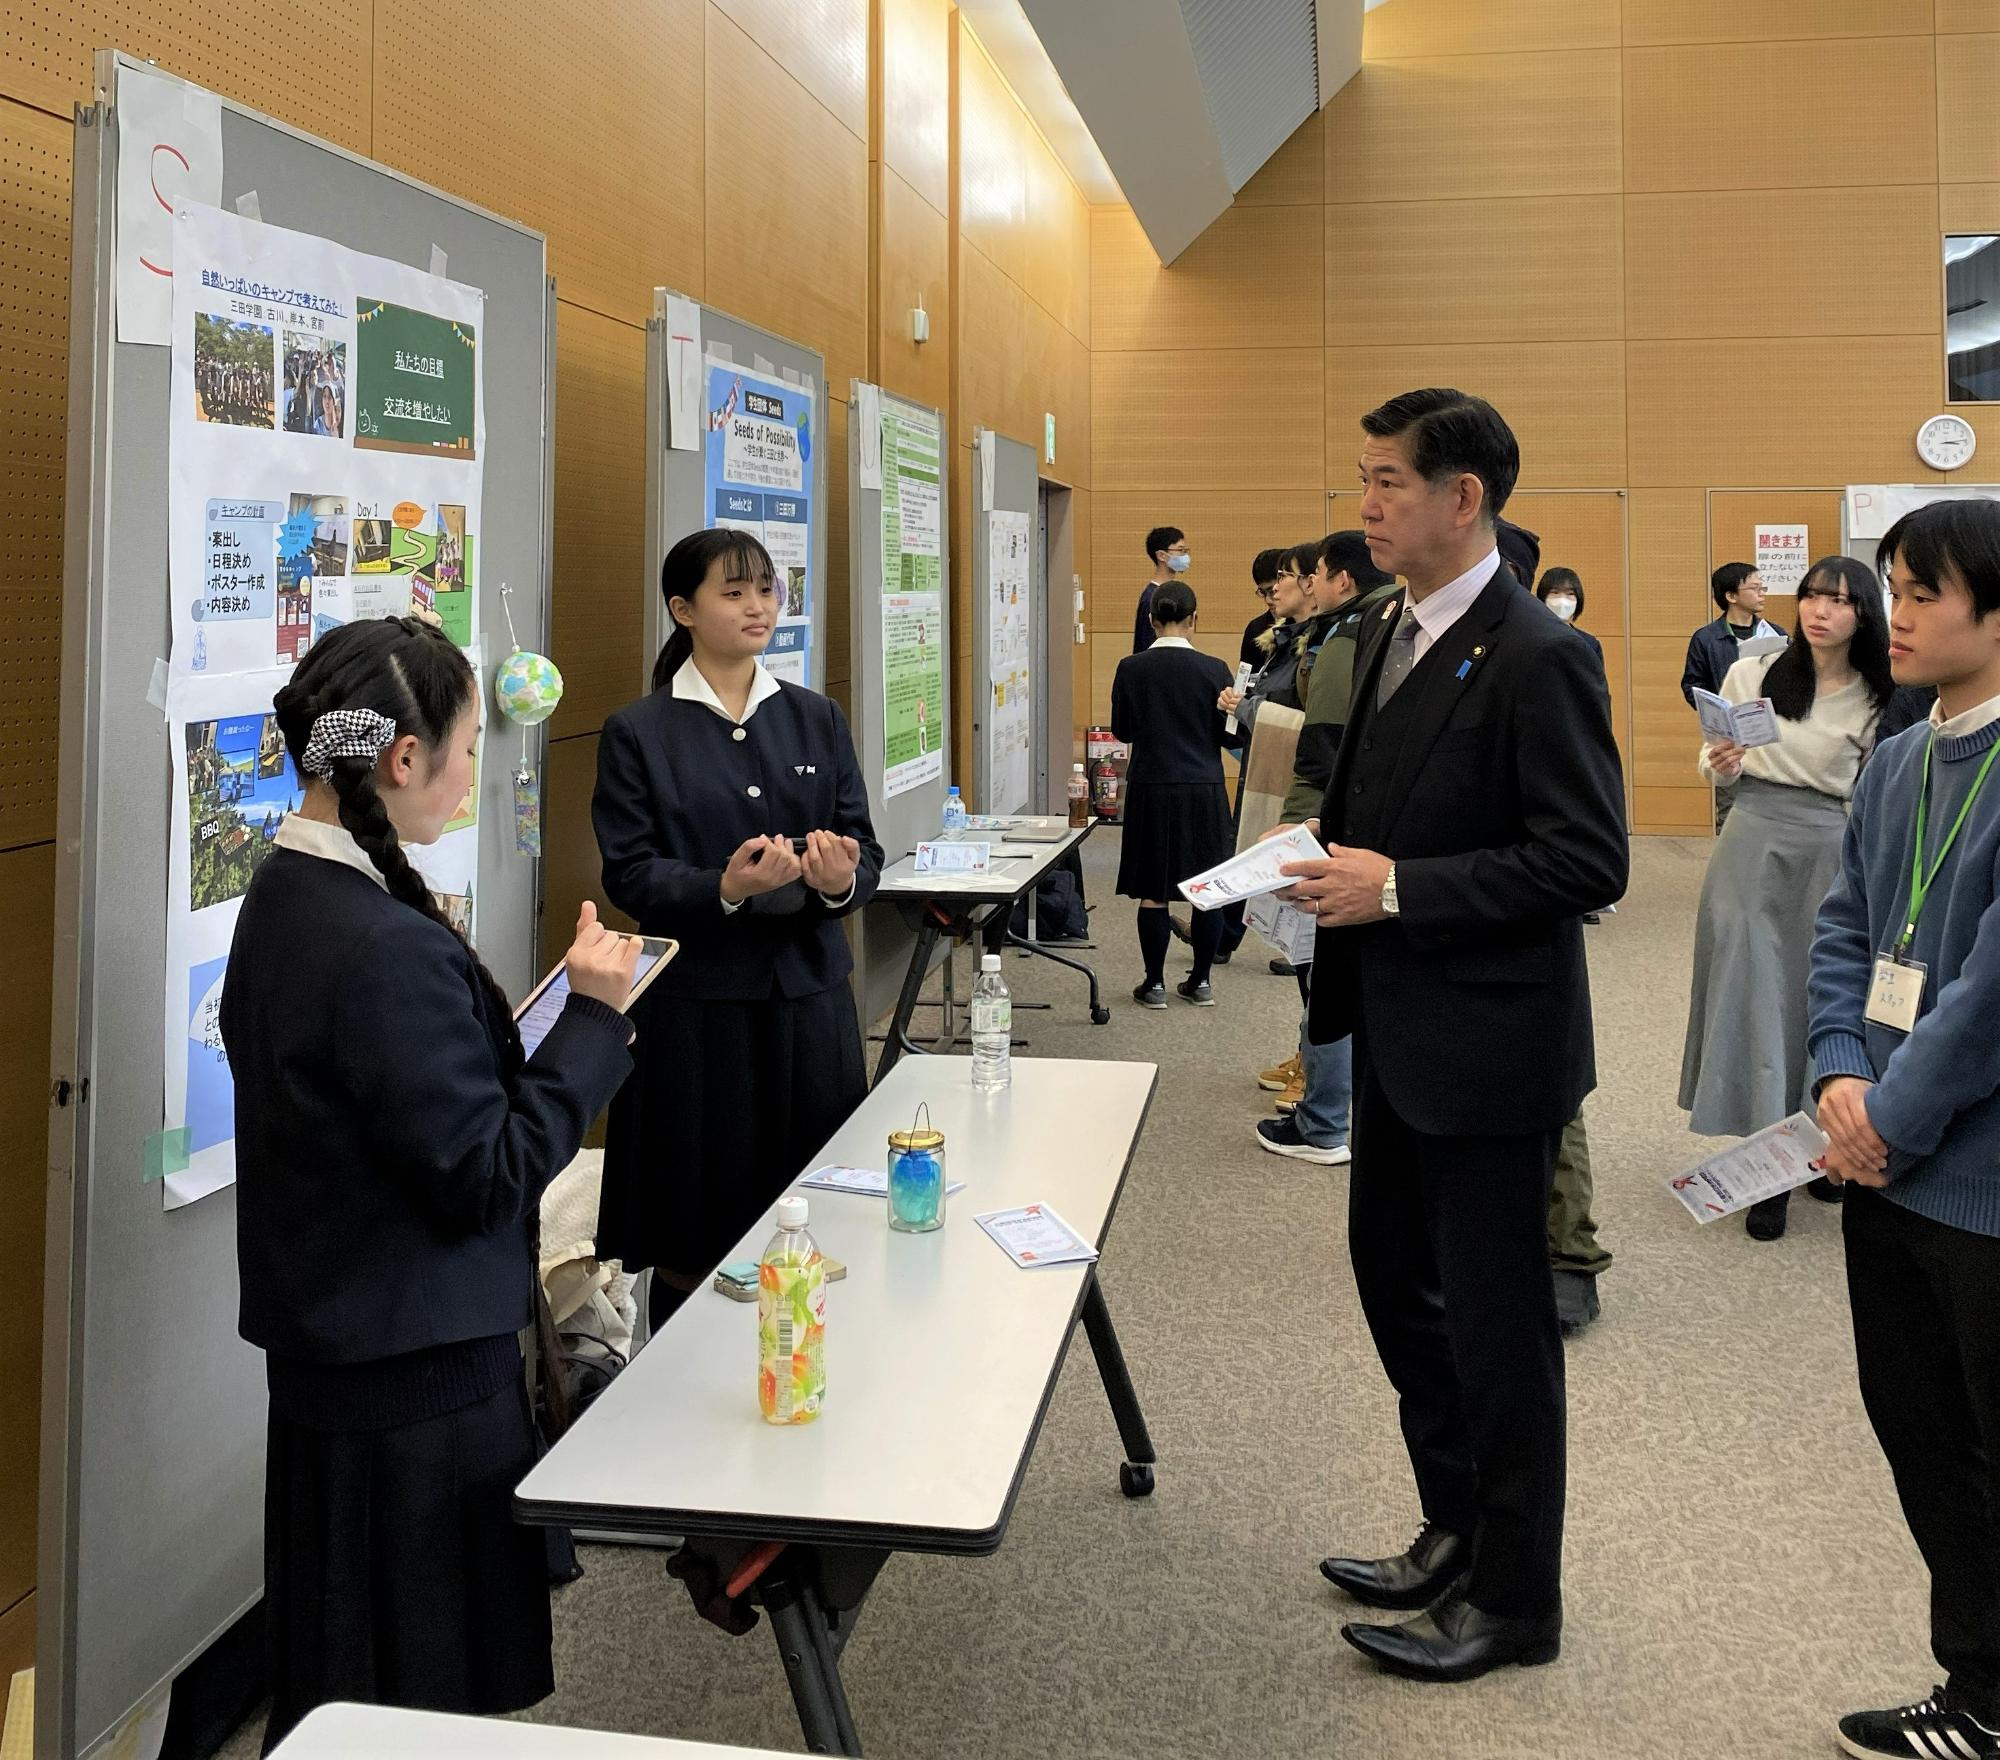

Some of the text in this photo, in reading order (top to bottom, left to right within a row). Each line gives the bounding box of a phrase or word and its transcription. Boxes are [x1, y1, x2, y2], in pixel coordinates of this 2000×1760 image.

[395, 350, 444, 377] 私たちの目標
[672, 335, 694, 413] T
[384, 396, 451, 423] 交流を増やしたい
[734, 419, 796, 454] Seeds of Possibility
[221, 504, 265, 518] キャンプの計画
[357, 502, 372, 517] Day
[1854, 493, 1872, 525] P
[1759, 534, 1805, 548] 開きます
[1760, 574, 1798, 582] ください
[201, 820, 220, 840] BBQ
